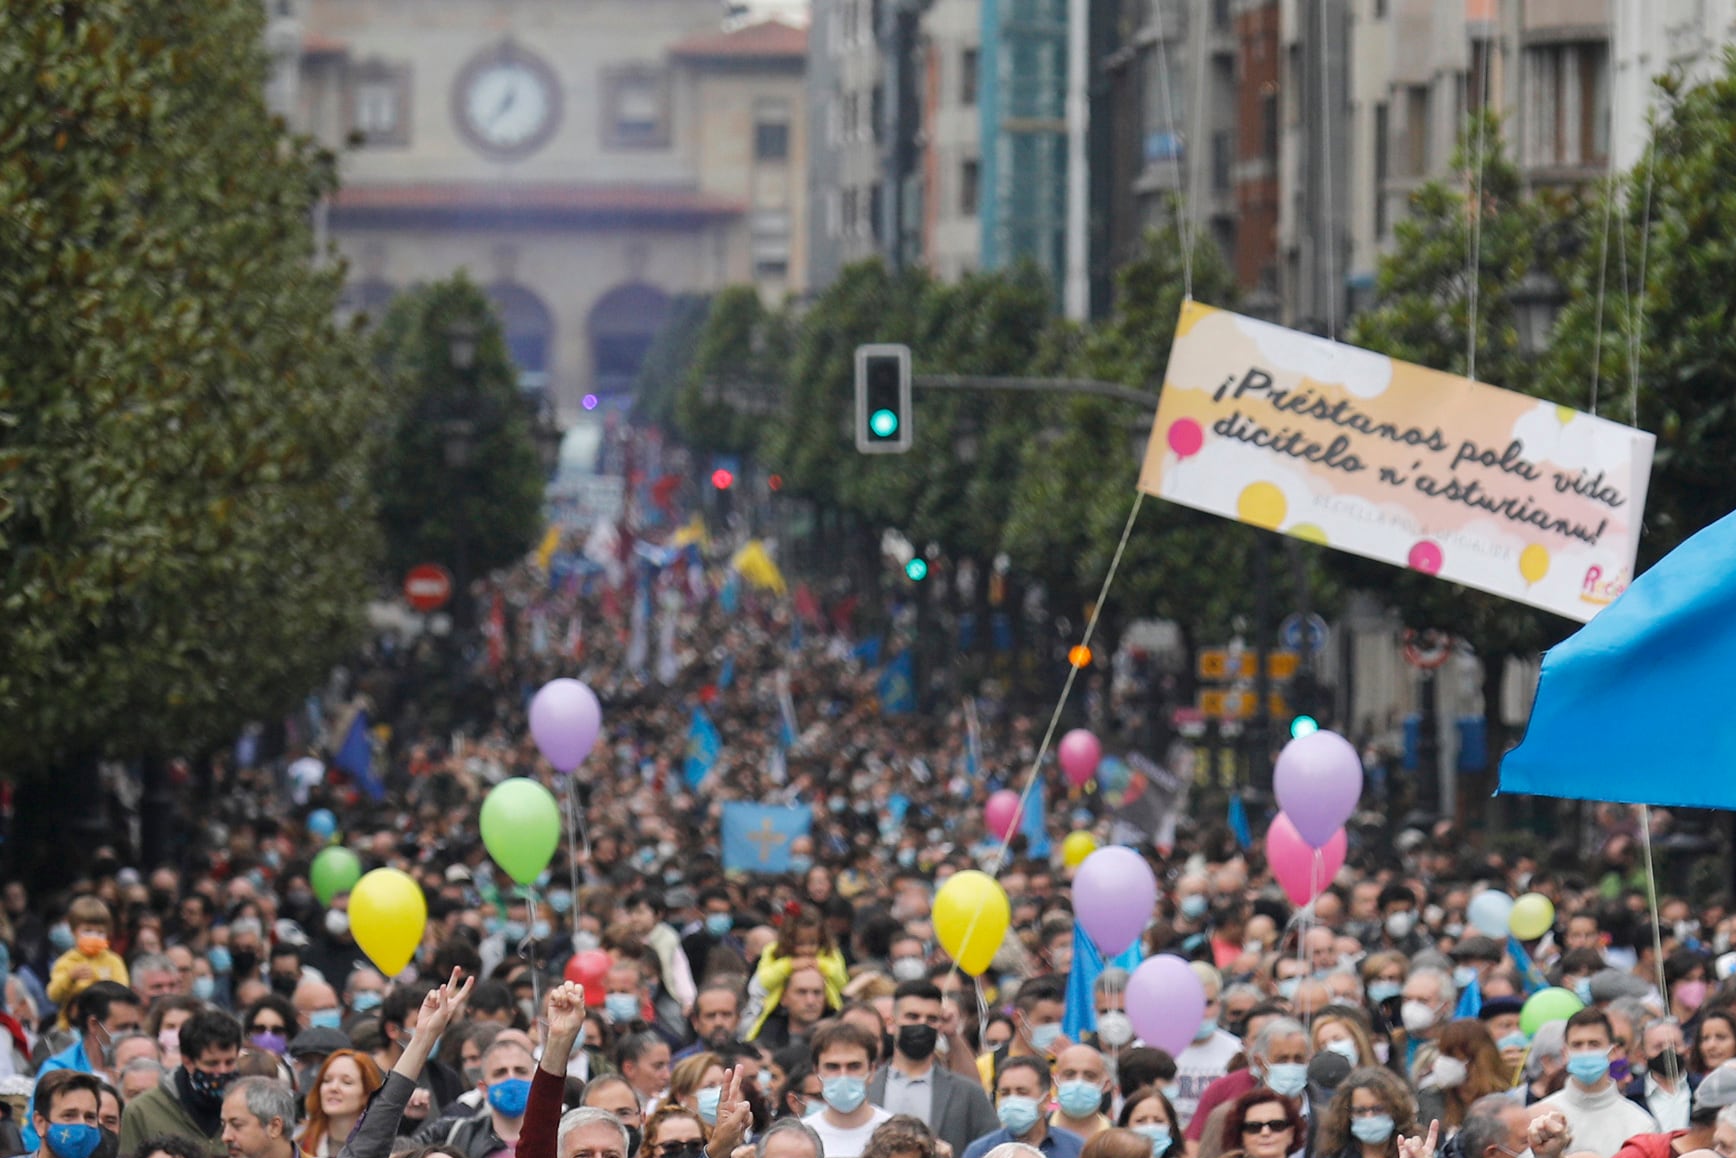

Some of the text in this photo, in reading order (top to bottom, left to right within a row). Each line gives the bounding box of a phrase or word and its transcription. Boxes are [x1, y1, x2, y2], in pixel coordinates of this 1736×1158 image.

[1212, 367, 1626, 509] ¡Préstanos pola vida
[1213, 411, 1368, 474] dicítelo
